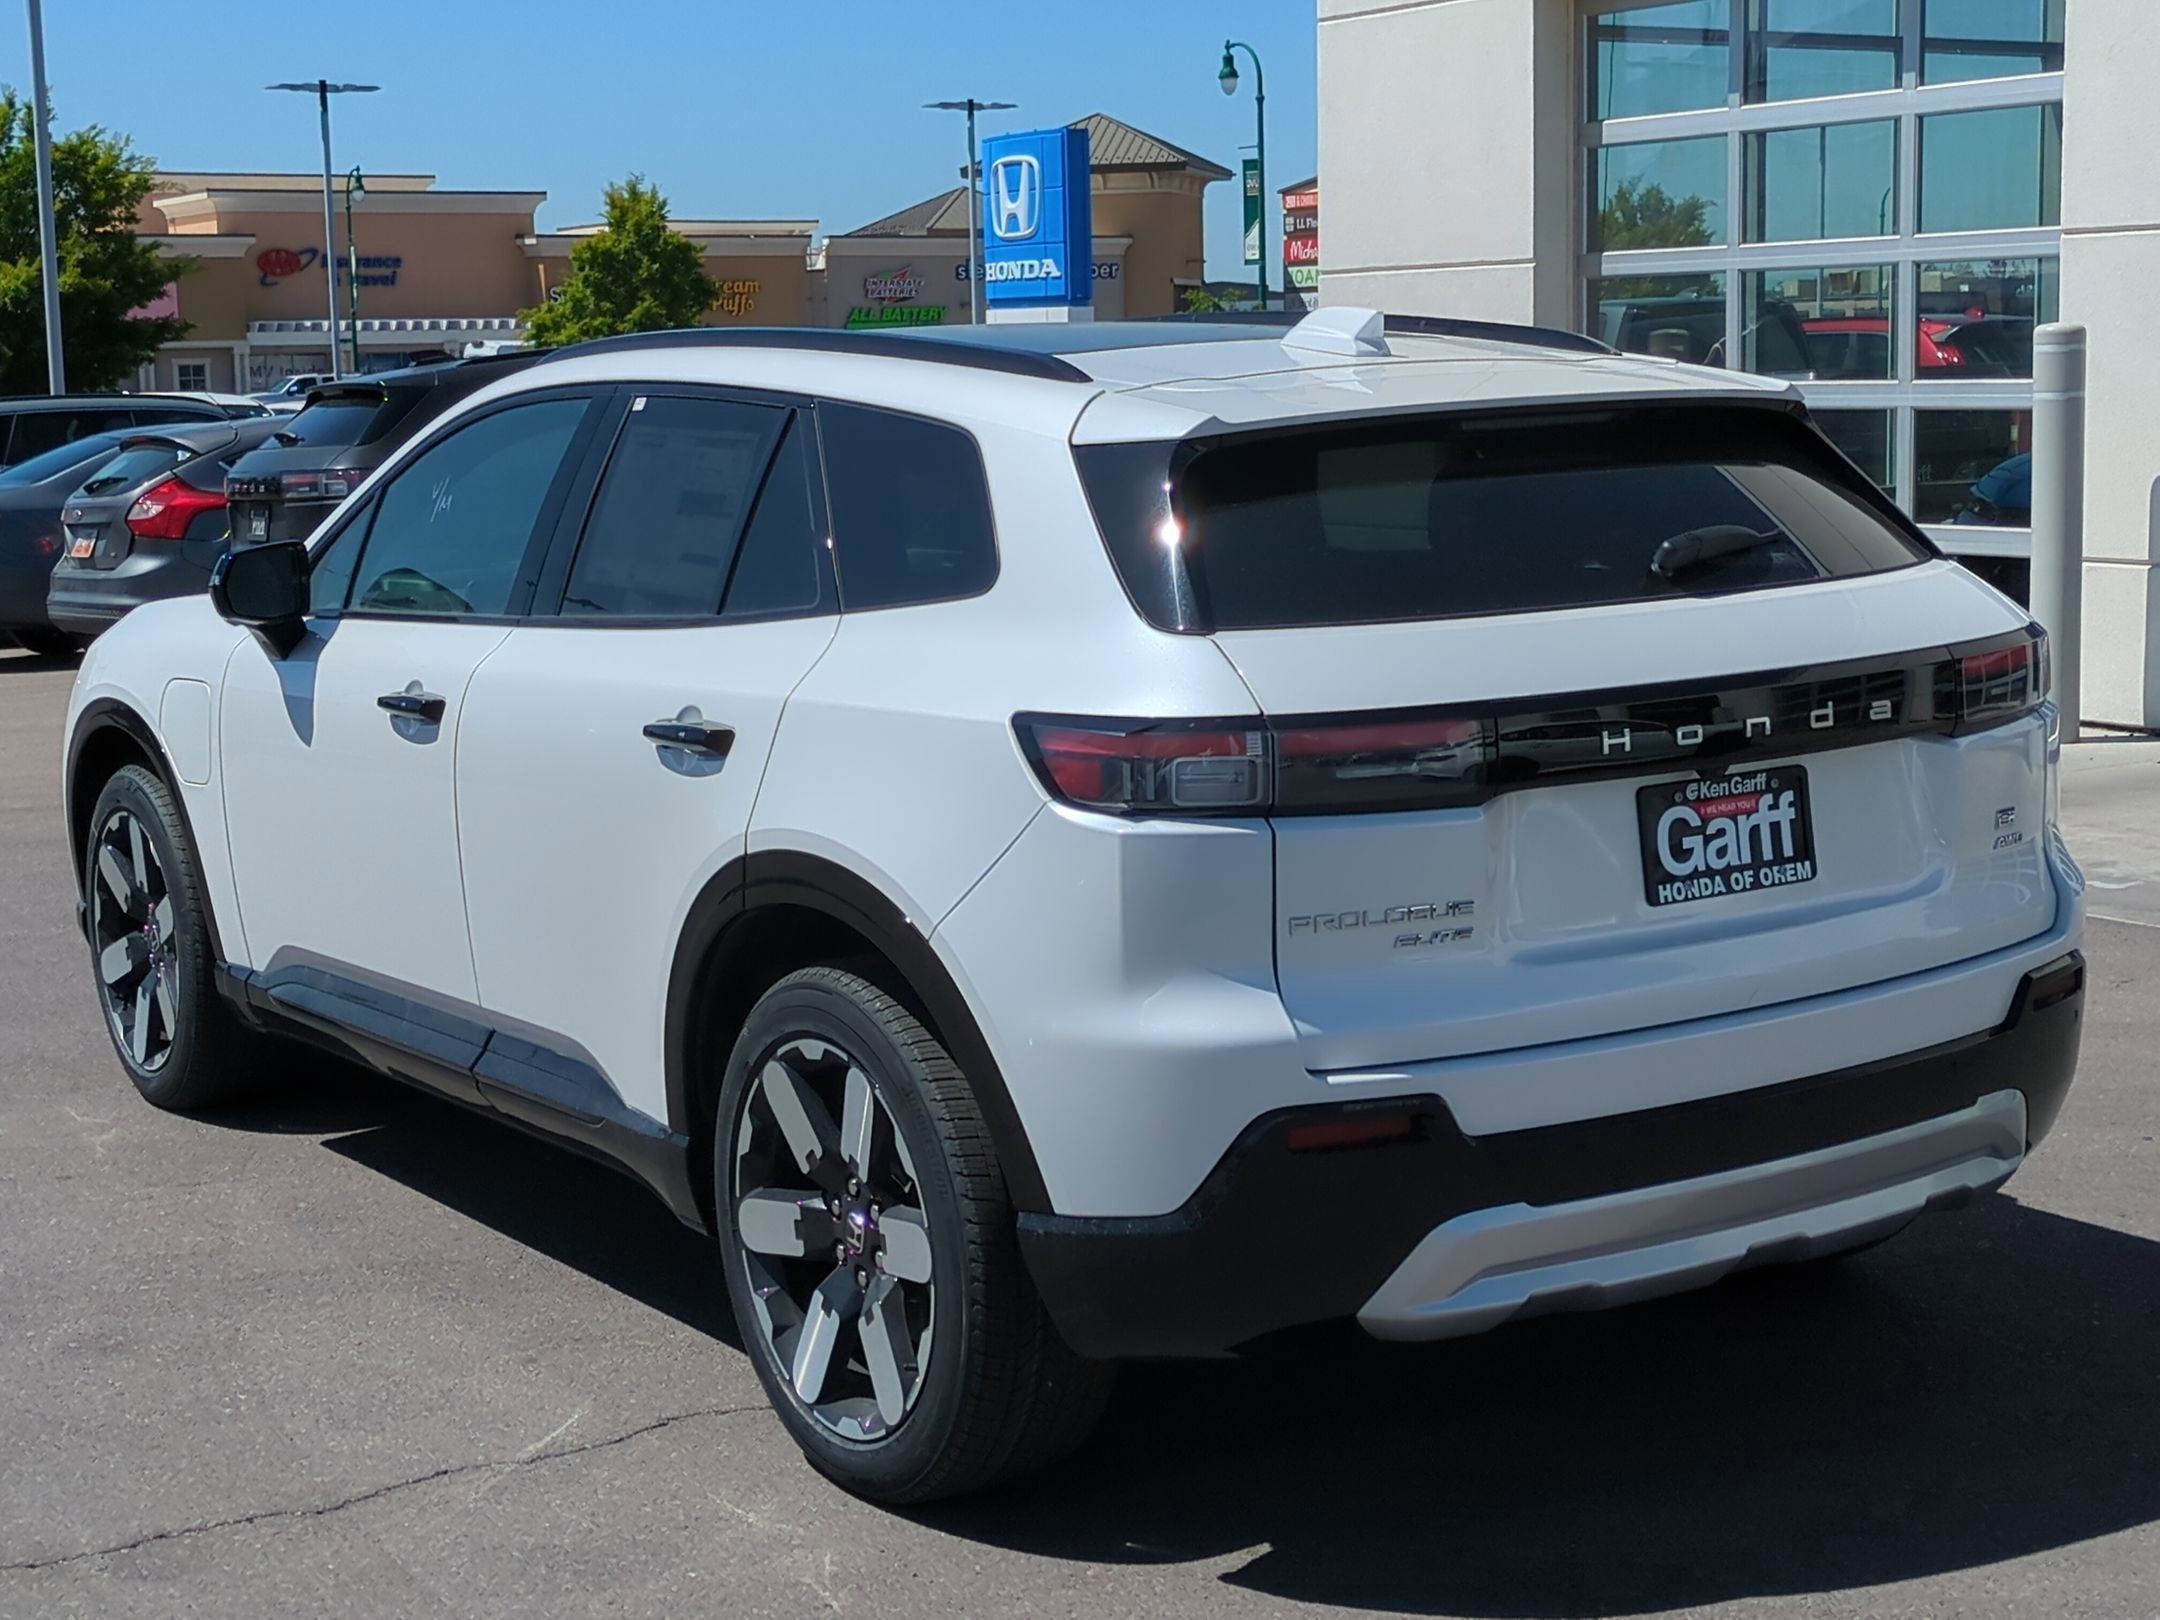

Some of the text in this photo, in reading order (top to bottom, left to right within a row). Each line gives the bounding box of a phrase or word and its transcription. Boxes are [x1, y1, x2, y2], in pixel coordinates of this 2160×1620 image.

[985, 259, 1061, 281] HONDA
[850, 305, 946, 321] ALL BATTERY
[1602, 700, 1892, 755] Honda
[1700, 773, 1767, 799] Ken Garff
[1737, 800, 1751, 810] YOU
[1657, 790, 1796, 876] Garff
[1658, 861, 1813, 904] HONDA OF OREM
[1288, 900, 1475, 939] PROLOGUE
[1393, 927, 1475, 948] ELITE
